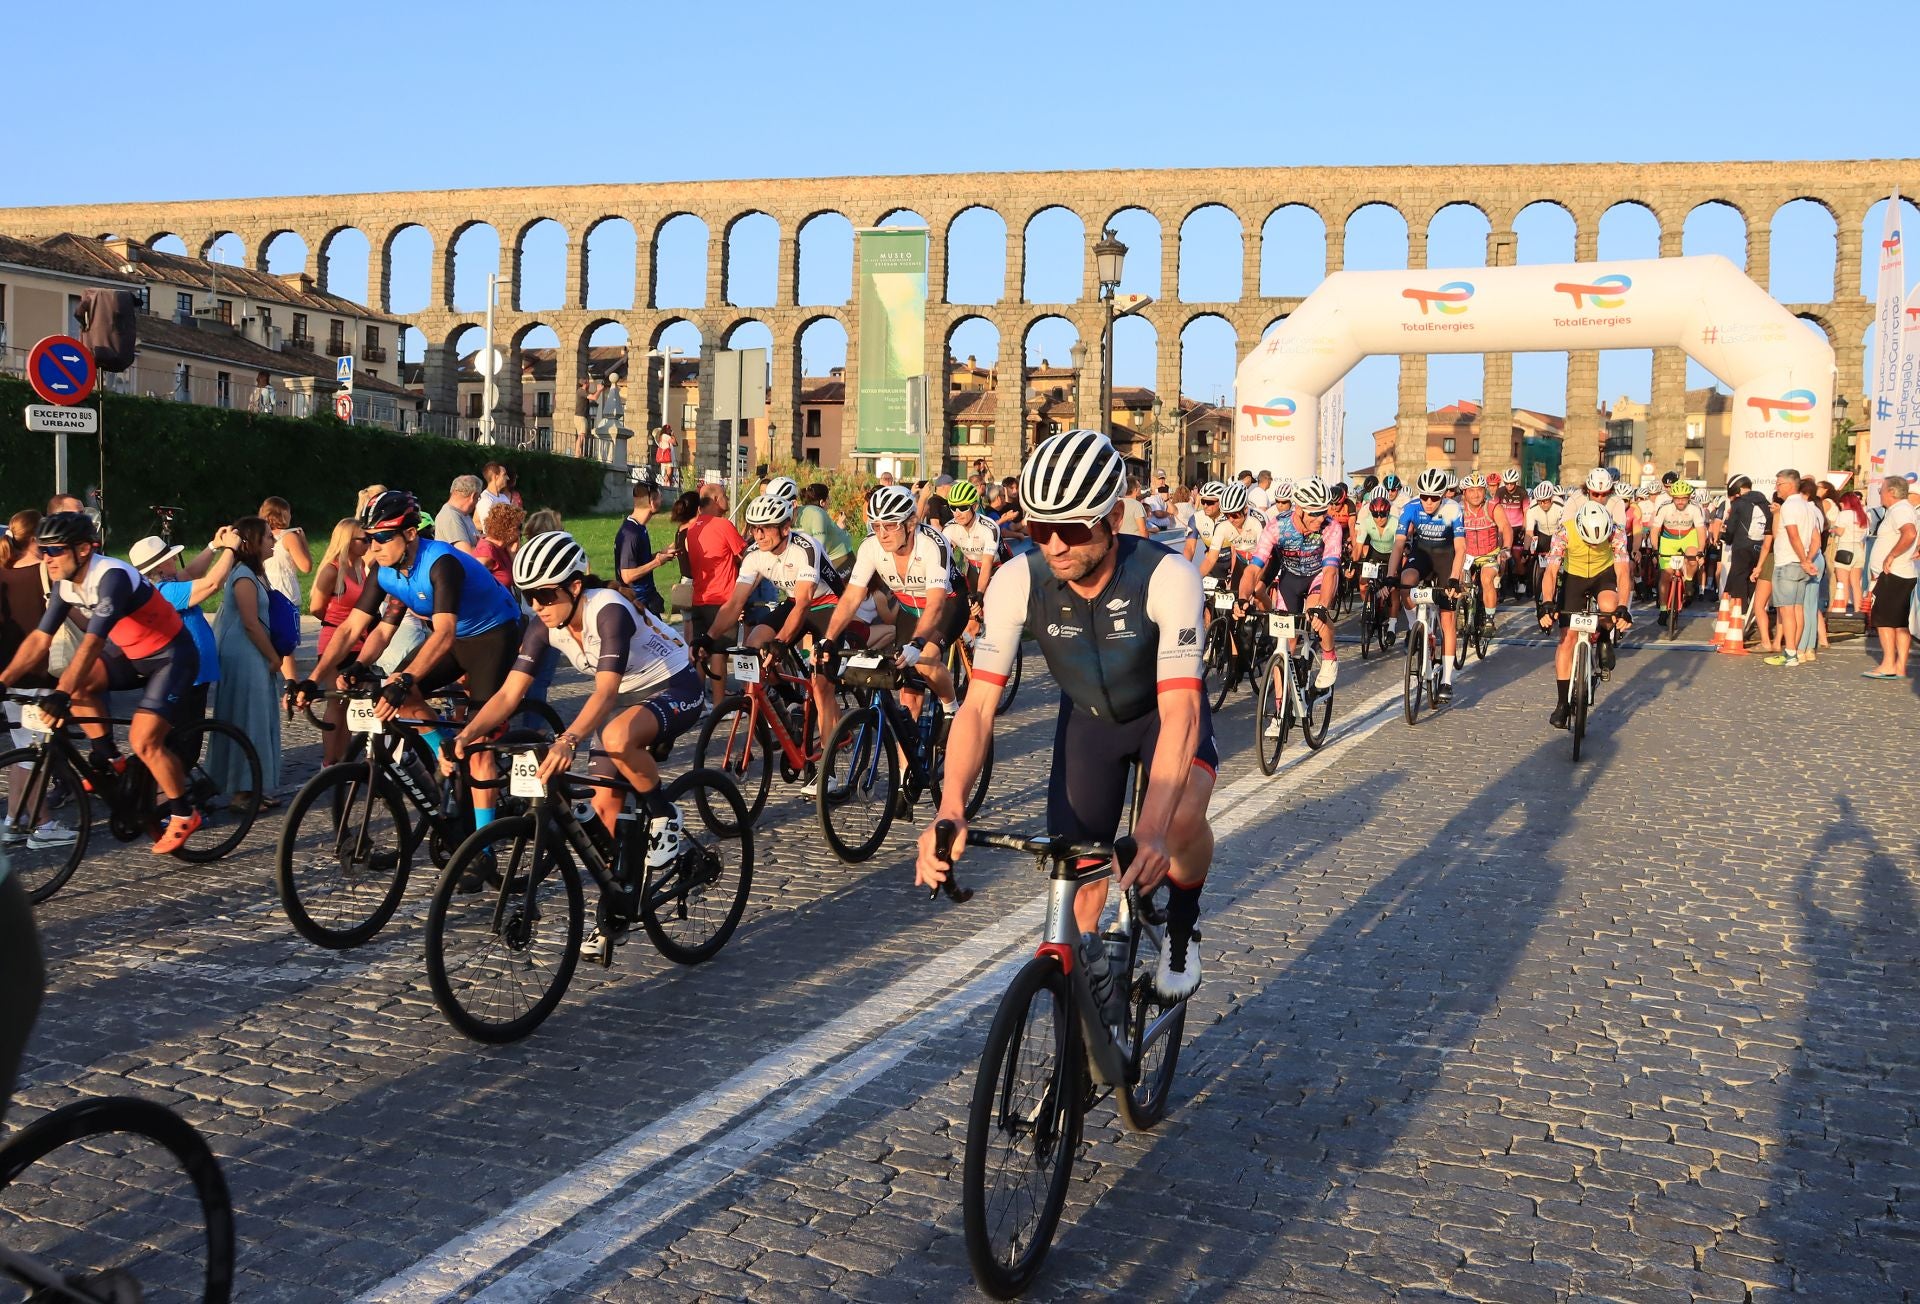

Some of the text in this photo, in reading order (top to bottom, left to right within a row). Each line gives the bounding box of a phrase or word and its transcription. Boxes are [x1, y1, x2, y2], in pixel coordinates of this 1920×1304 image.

[1553, 315, 1632, 328] TotalEnergies
[1401, 321, 1475, 333] TotalEnergies
[1896, 352, 1915, 429] LaEnergiaDe
[33, 409, 93, 420] EXCEPTO BUS
[42, 420, 85, 428] URBANO
[1241, 433, 1295, 443] TotalEnergies
[1745, 430, 1815, 440] TotalEnergies
[1273, 621, 1290, 629] 434
[737, 661, 754, 670] 581
[350, 709, 374, 718] 766
